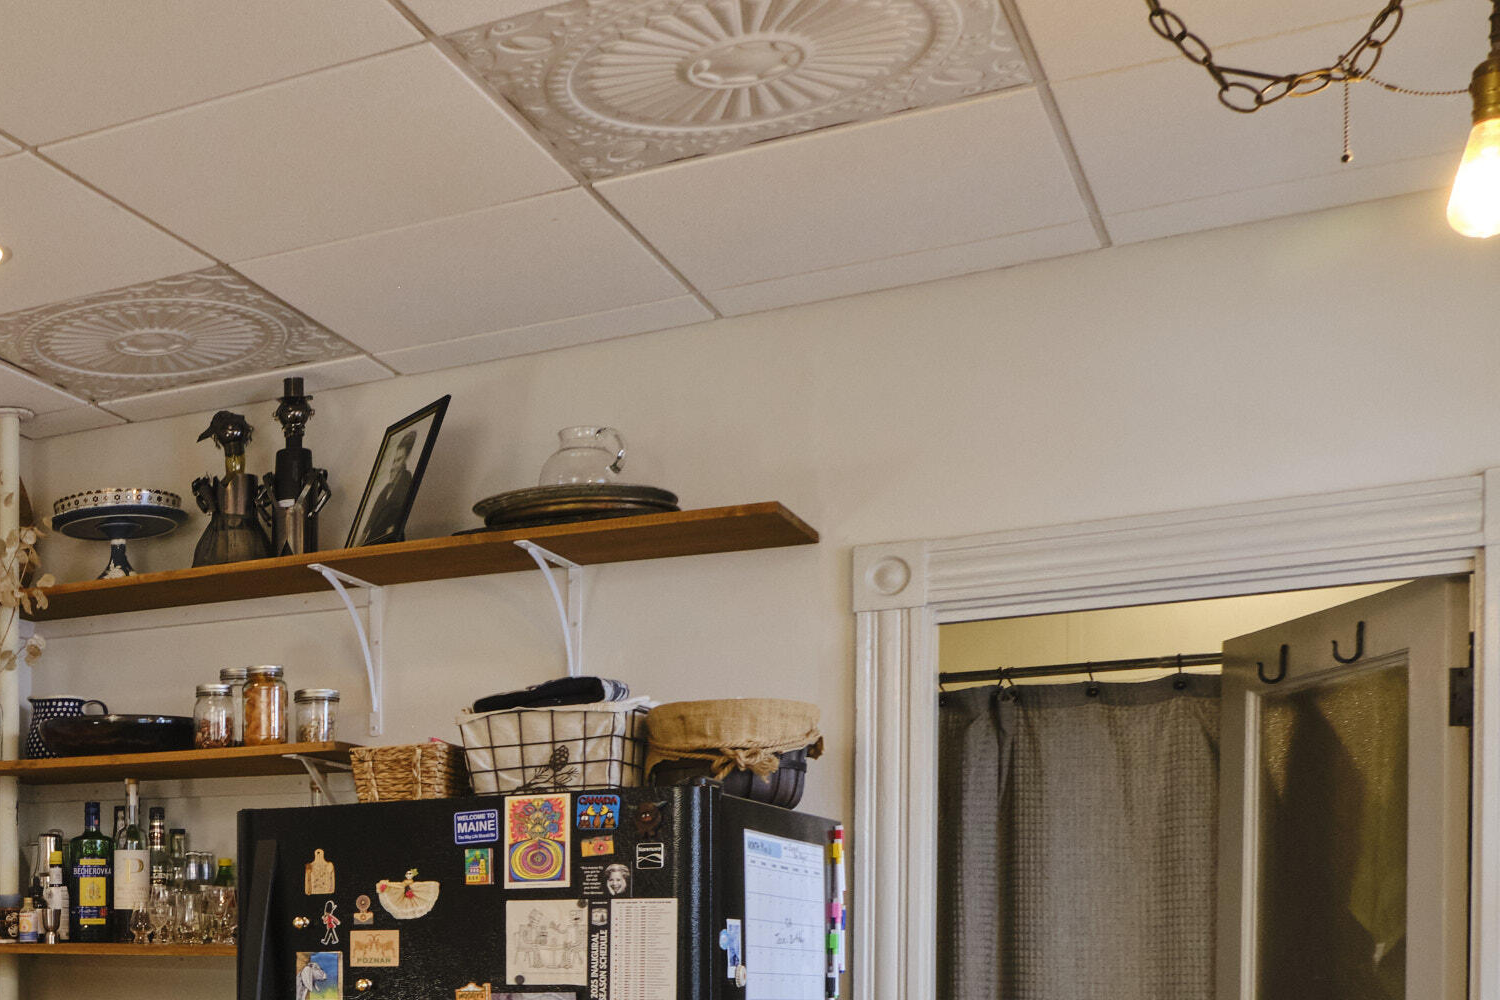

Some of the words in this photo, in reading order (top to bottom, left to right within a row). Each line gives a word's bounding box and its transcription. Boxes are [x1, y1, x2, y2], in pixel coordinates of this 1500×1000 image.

[579, 796, 617, 805] CANADA
[457, 813, 486, 821] WELCOME
[457, 820, 496, 833] MAINE
[73, 867, 112, 875] BECHEROVKA
[125, 858, 145, 882] P
[591, 932, 600, 977] INAUGURAL
[599, 929, 608, 969] SCHEDULE
[590, 981, 599, 999] 2025
